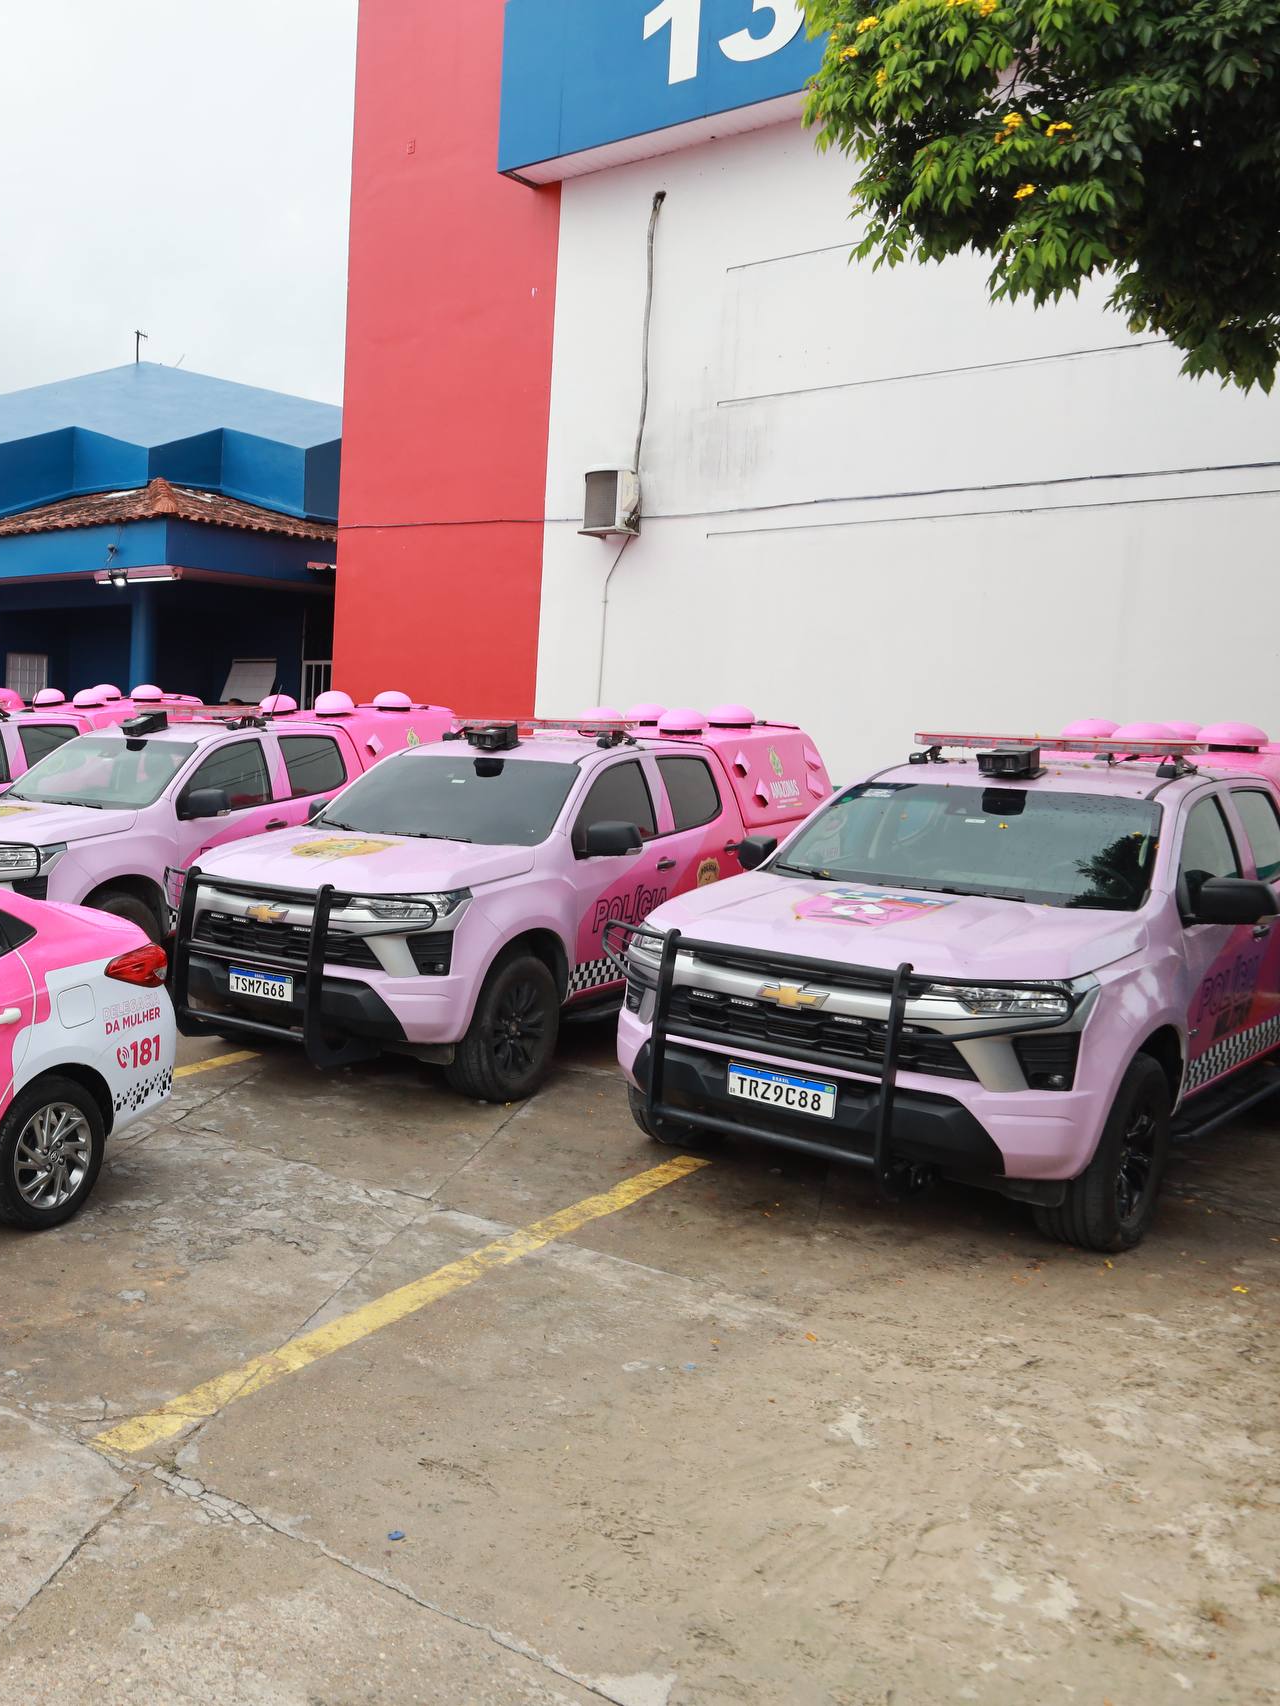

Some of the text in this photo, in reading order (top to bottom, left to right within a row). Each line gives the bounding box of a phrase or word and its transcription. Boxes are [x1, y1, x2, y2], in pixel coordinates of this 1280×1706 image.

[234, 976, 285, 998] TSM7G68
[105, 1007, 161, 1035] DA MULHER
[130, 1034, 161, 1069] 181
[737, 1077, 822, 1111] TRZ9C88
